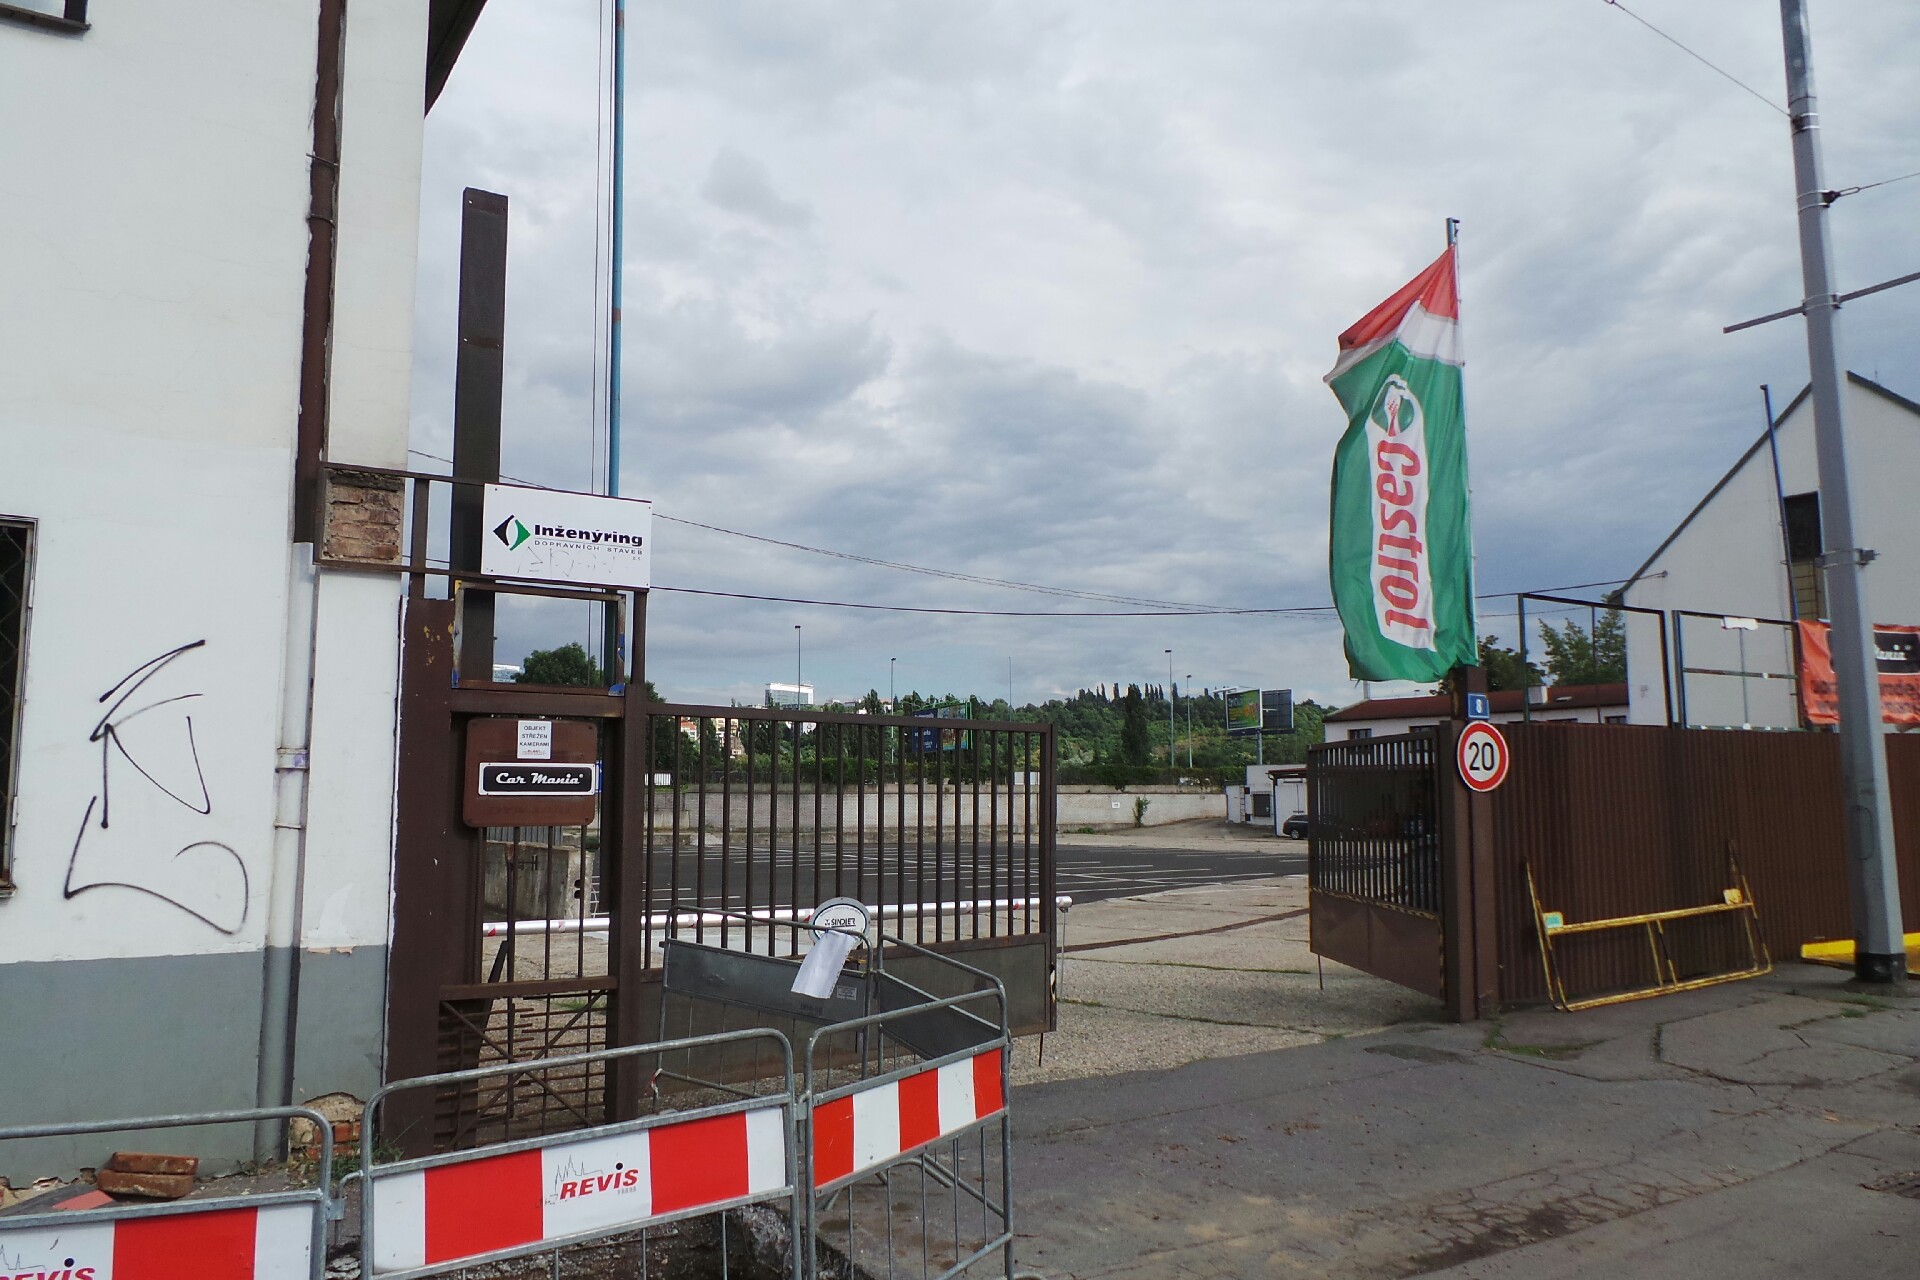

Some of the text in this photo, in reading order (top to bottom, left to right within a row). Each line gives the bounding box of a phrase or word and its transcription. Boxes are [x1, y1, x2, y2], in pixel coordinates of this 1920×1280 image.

[534, 524, 643, 547] Inženýring
[1375, 438, 1430, 630] Castrol
[607, 547, 643, 555] STAVEB
[1468, 741, 1495, 771] 20
[495, 772, 527, 784] Car
